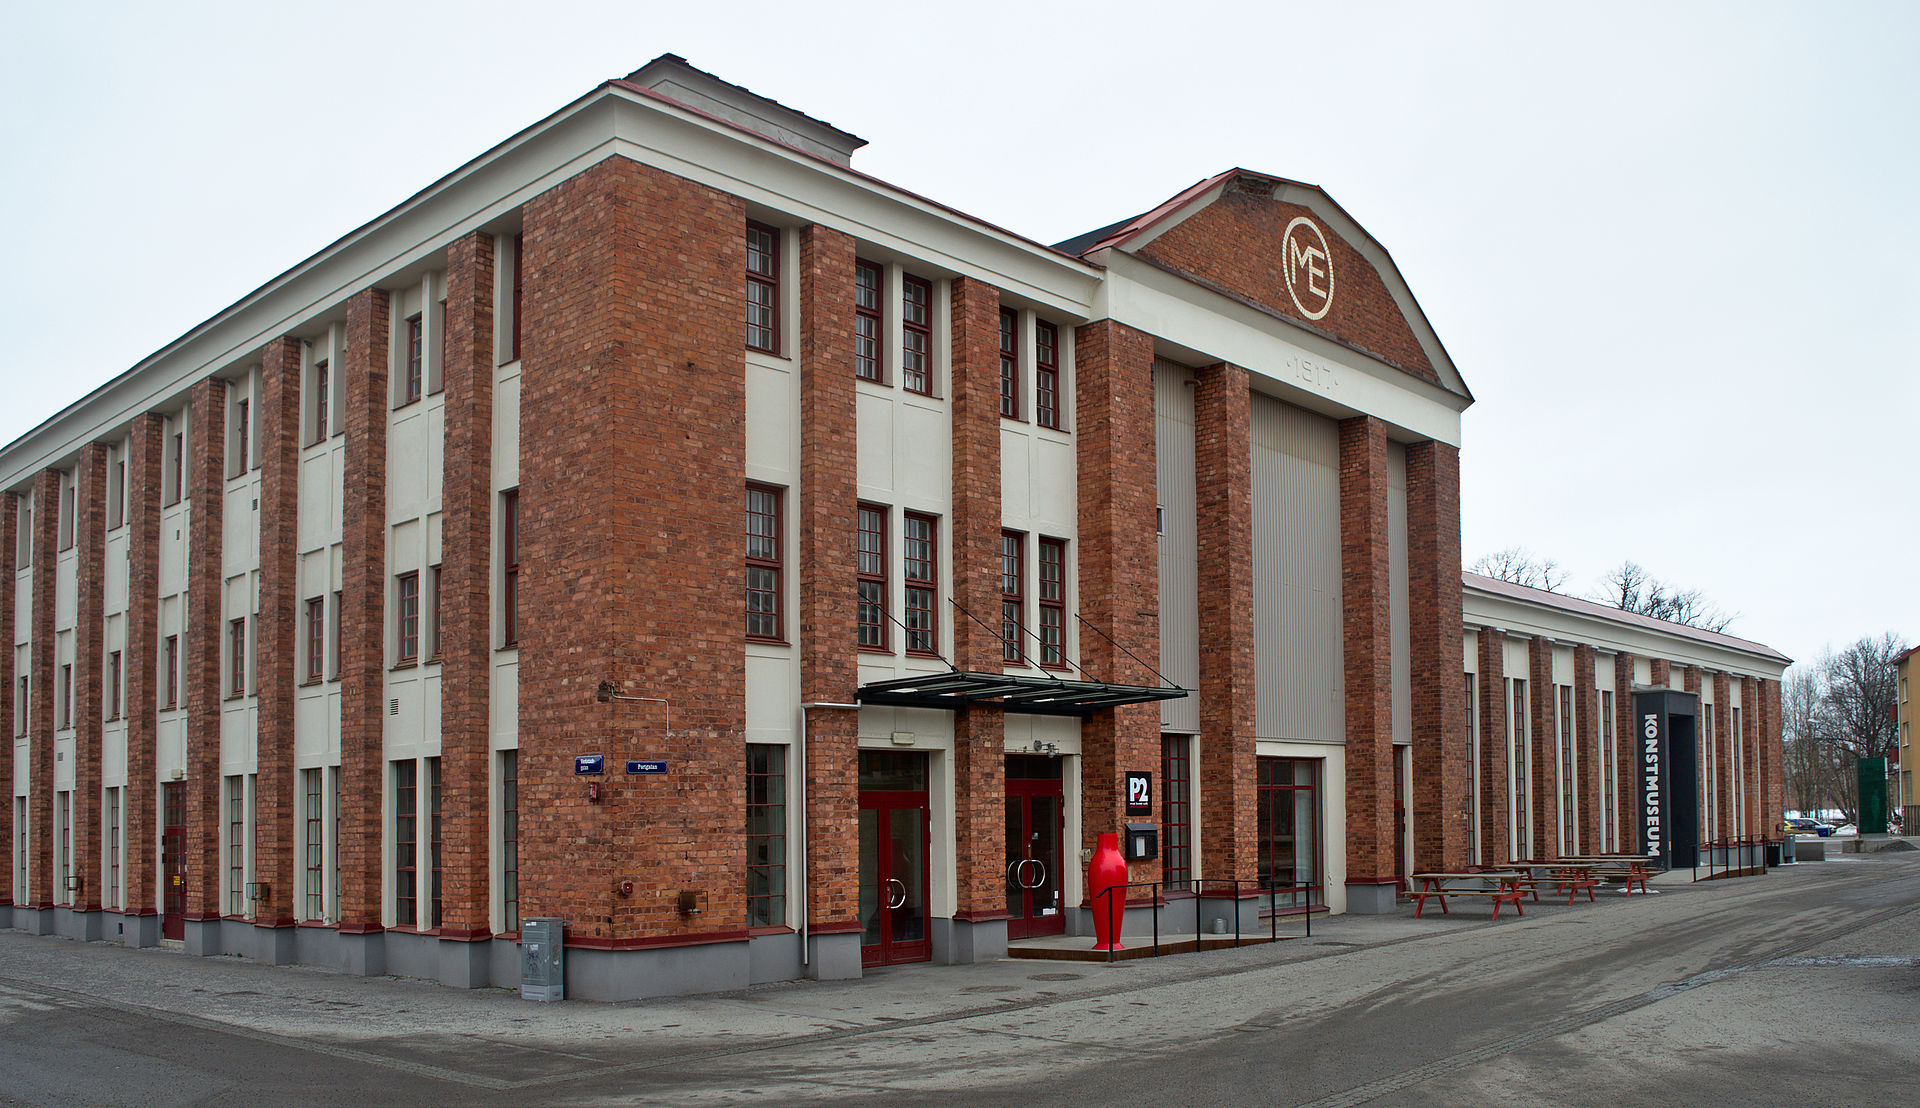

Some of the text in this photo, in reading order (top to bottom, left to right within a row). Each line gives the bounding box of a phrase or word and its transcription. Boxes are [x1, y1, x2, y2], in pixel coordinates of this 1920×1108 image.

[1290, 236, 1327, 299] ME
[1129, 777, 1149, 802] P2
[1645, 714, 1660, 856] KONSTMUSEUM
